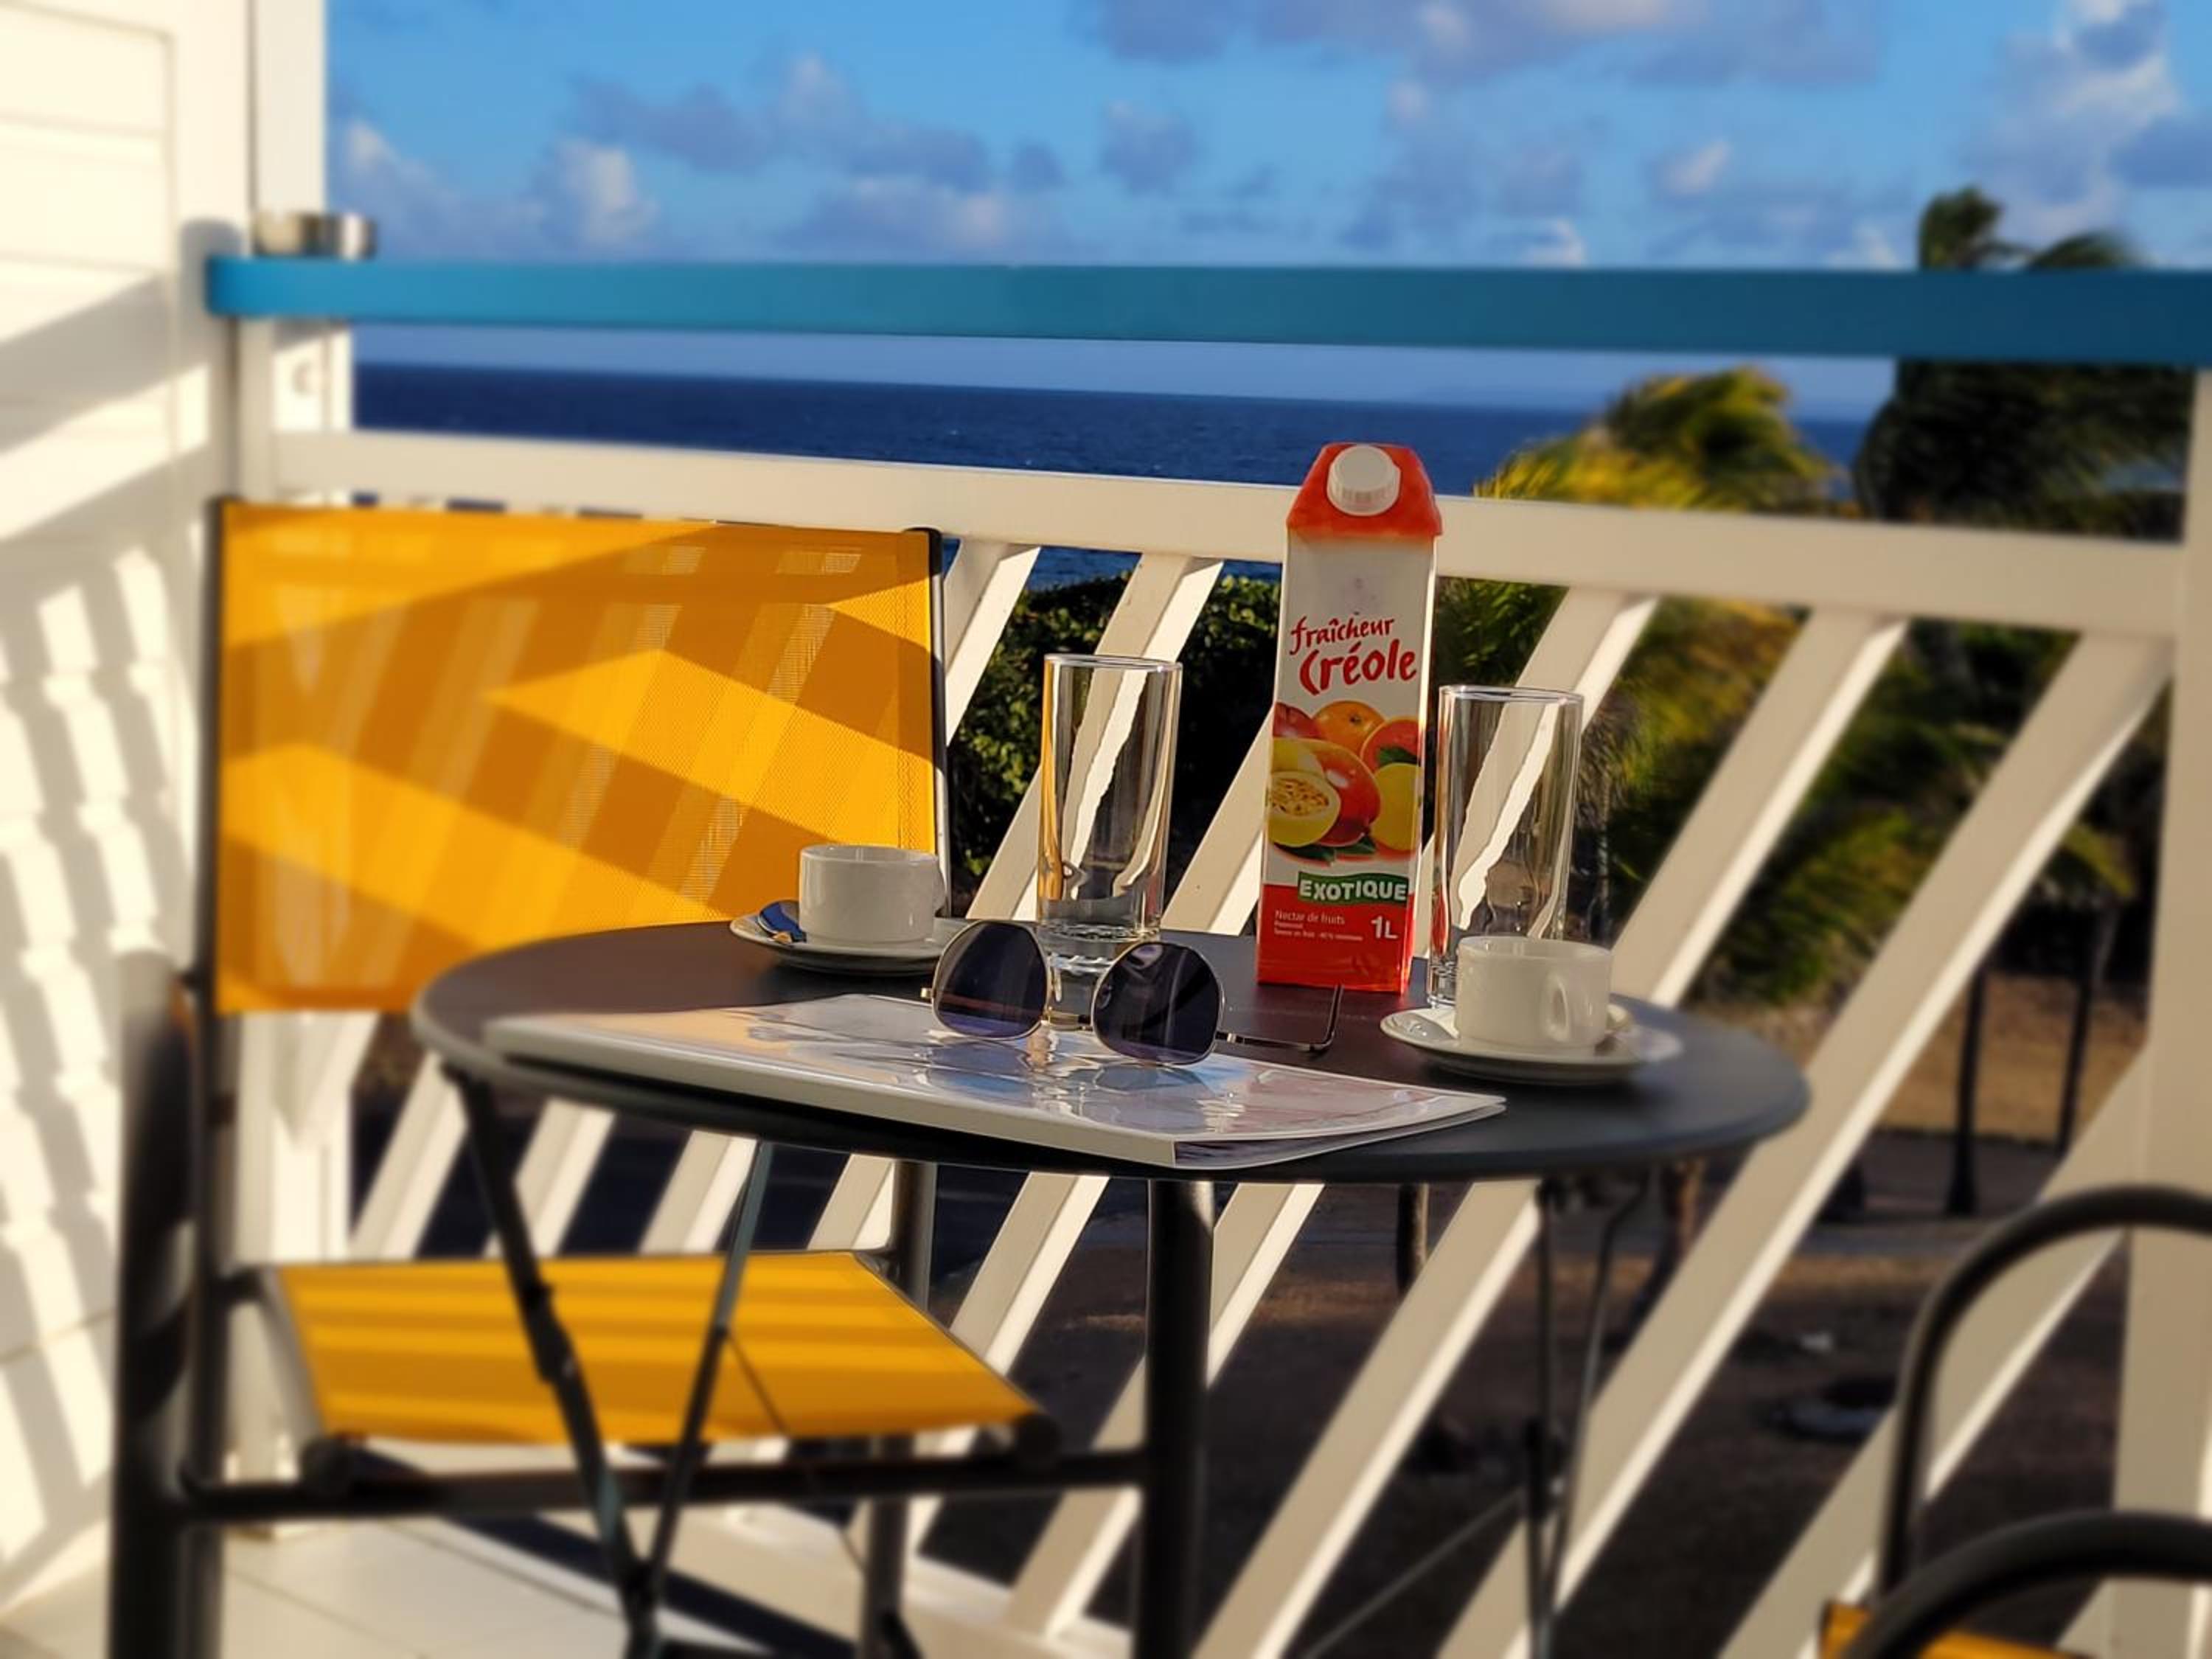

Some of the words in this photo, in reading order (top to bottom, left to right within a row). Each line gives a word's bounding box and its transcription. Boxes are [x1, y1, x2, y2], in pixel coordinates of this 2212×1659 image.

[1290, 616, 1394, 655] fraîcheur
[1299, 639, 1417, 696] Créole
[1298, 879, 1407, 901] EXOTIQUE
[1275, 909, 1305, 922] Nectar
[1307, 913, 1320, 922] de
[1371, 915, 1399, 940] 1L
